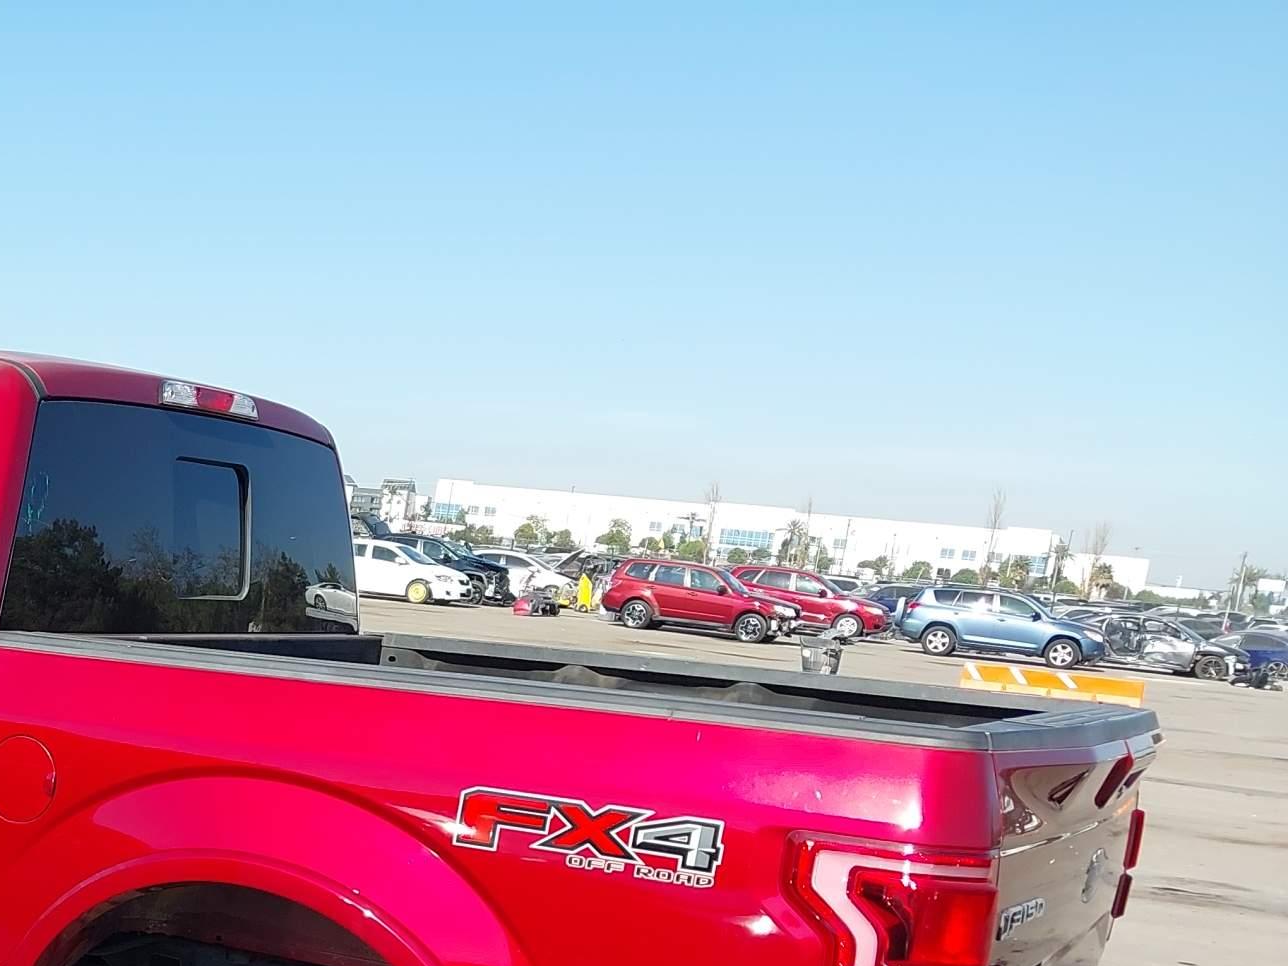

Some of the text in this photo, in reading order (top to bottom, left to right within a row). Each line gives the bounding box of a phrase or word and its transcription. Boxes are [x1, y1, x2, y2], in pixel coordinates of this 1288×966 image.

[452, 786, 725, 875] FX4
[565, 853, 715, 888] OFF ROAD
